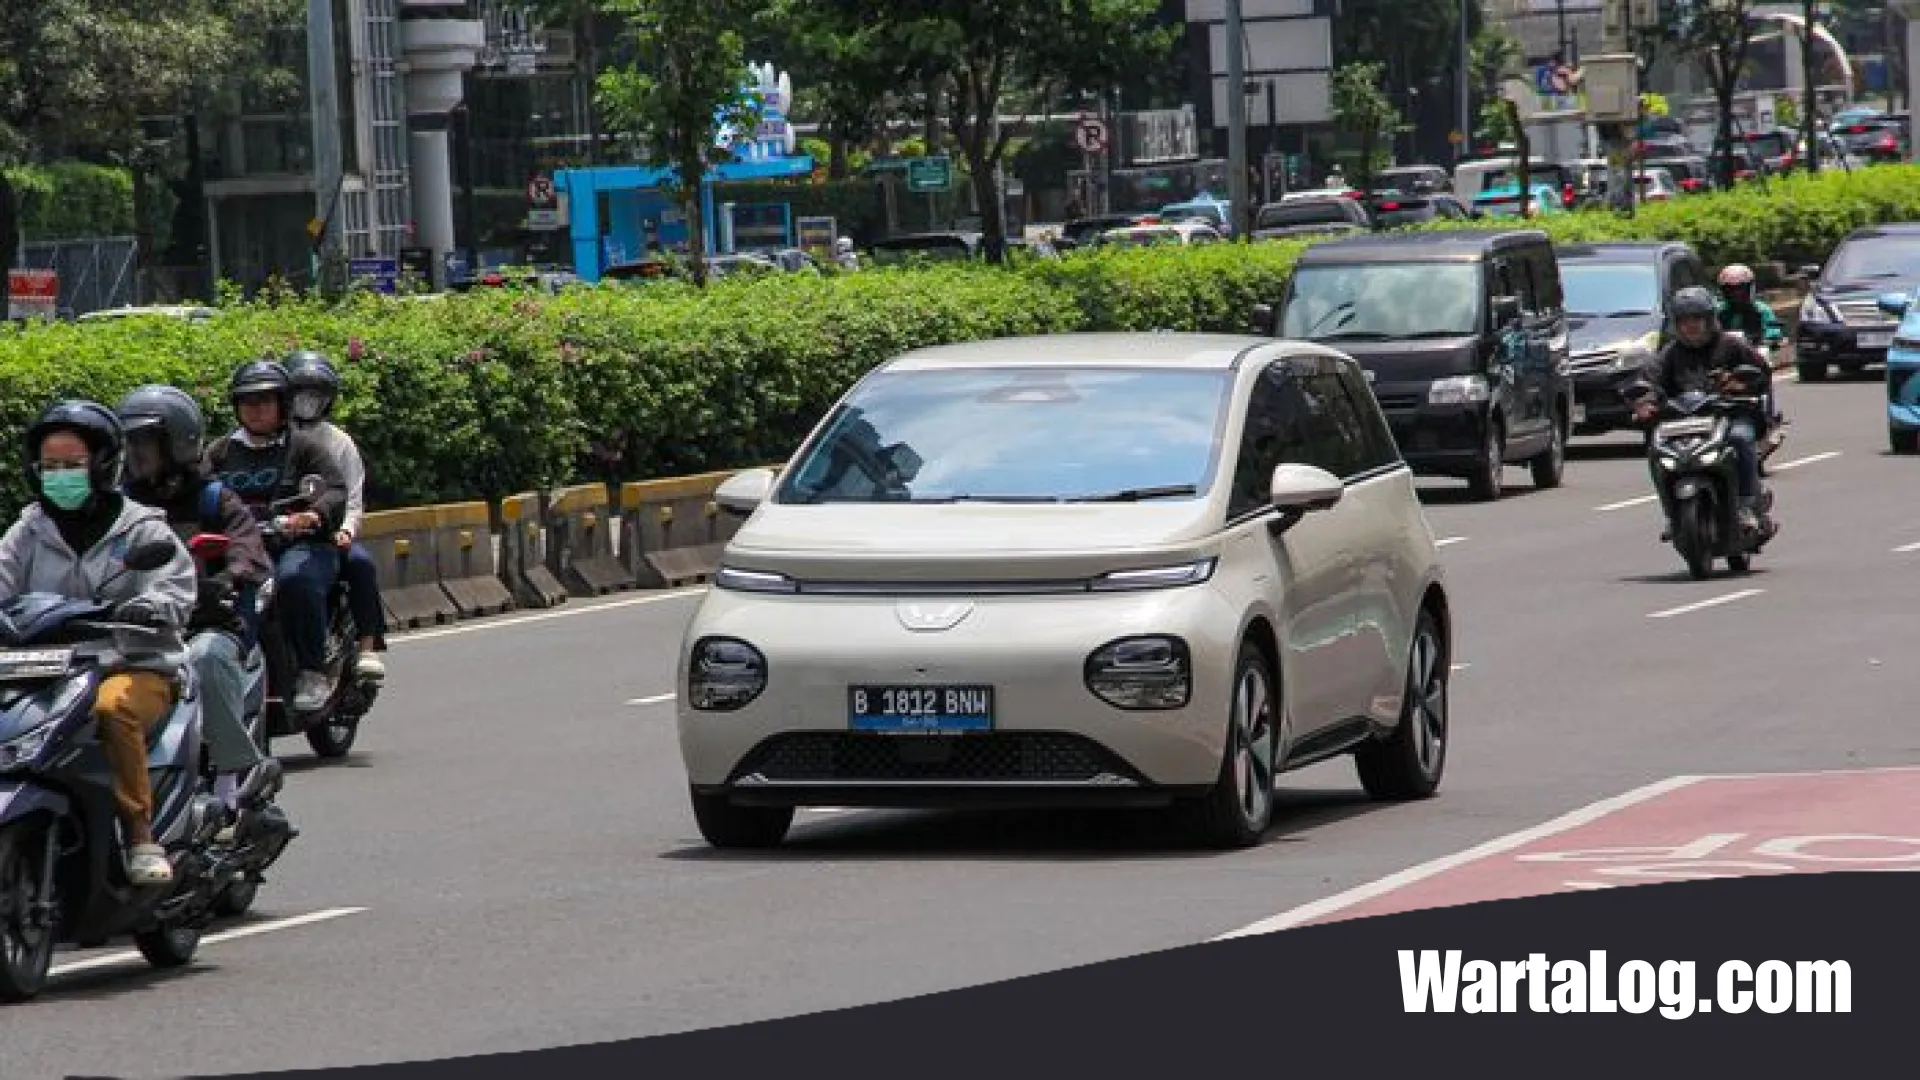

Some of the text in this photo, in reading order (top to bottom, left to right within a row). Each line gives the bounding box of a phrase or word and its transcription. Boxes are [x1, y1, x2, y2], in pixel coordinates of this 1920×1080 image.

[855, 690, 986, 714] B 1812 BNW
